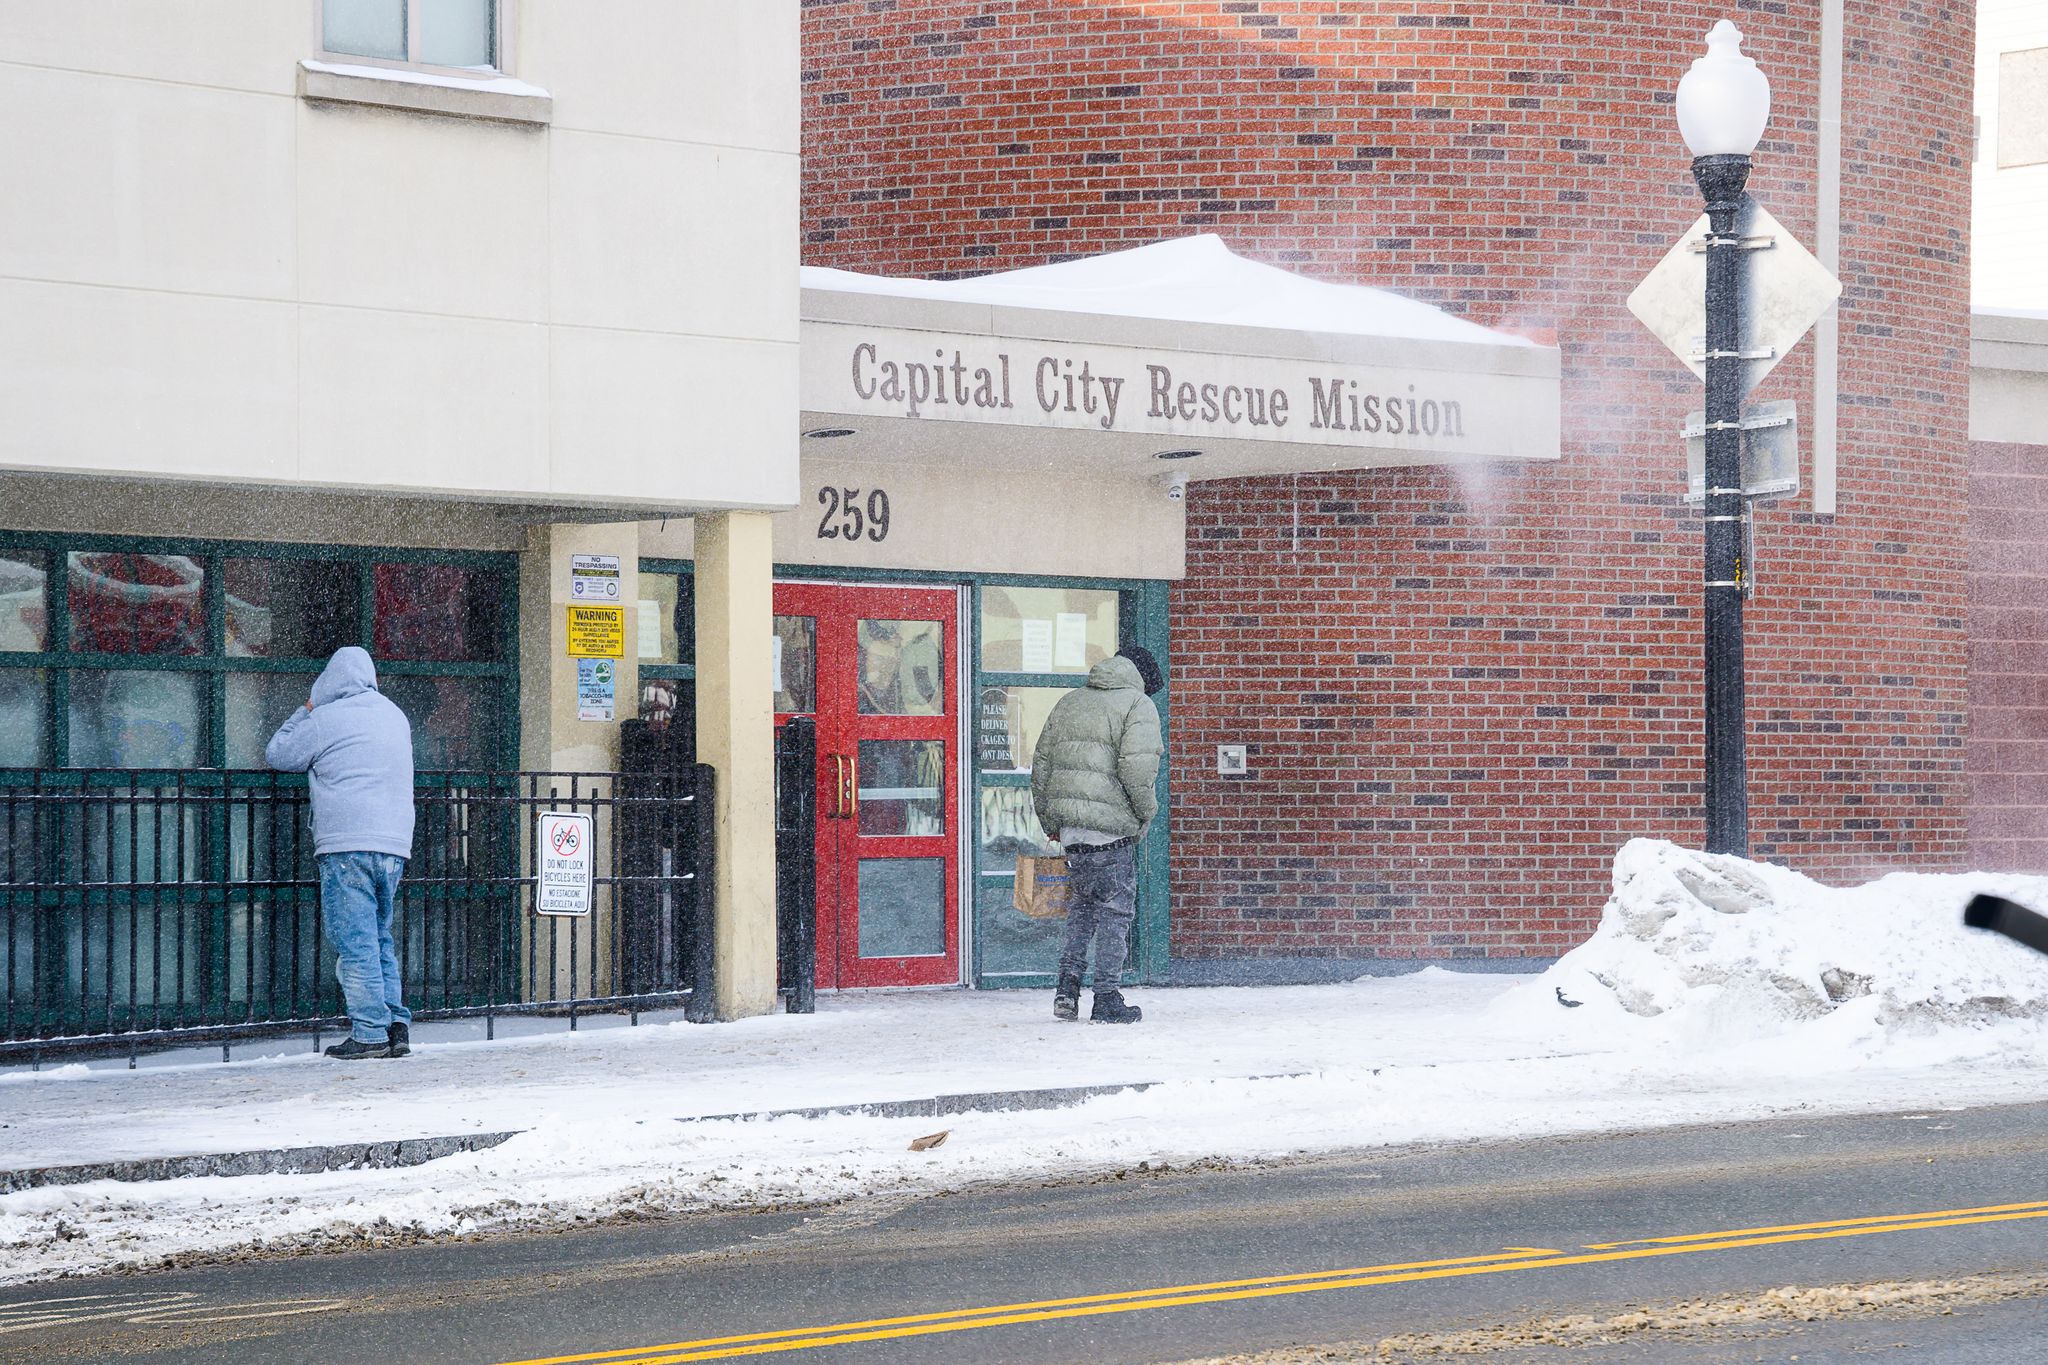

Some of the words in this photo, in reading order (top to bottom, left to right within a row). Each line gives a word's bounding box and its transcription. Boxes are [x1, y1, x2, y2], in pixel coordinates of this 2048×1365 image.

[852, 342, 1014, 418] Capital
[1035, 356, 1124, 429] City
[1145, 363, 1289, 427] Rescue
[1309, 376, 1465, 438] Mission
[817, 486, 890, 542] 259
[575, 610, 617, 621] WARNING
[983, 704, 1007, 715] PLEASE
[981, 719, 1008, 730] DELIVER
[1006, 735, 1016, 744] TO
[981, 750, 996, 760] ONT
[997, 750, 1014, 760] DESK
[547, 859, 555, 868] DO
[557, 859, 567, 869] NOT
[569, 860, 583, 870] LOCK
[544, 872, 571, 882] BICYCLES
[572, 873, 586, 883] HERE
[556, 889, 580, 898] ESTACIONE
[543, 899, 549, 907] SU
[550, 899, 573, 908] BICICLETA
